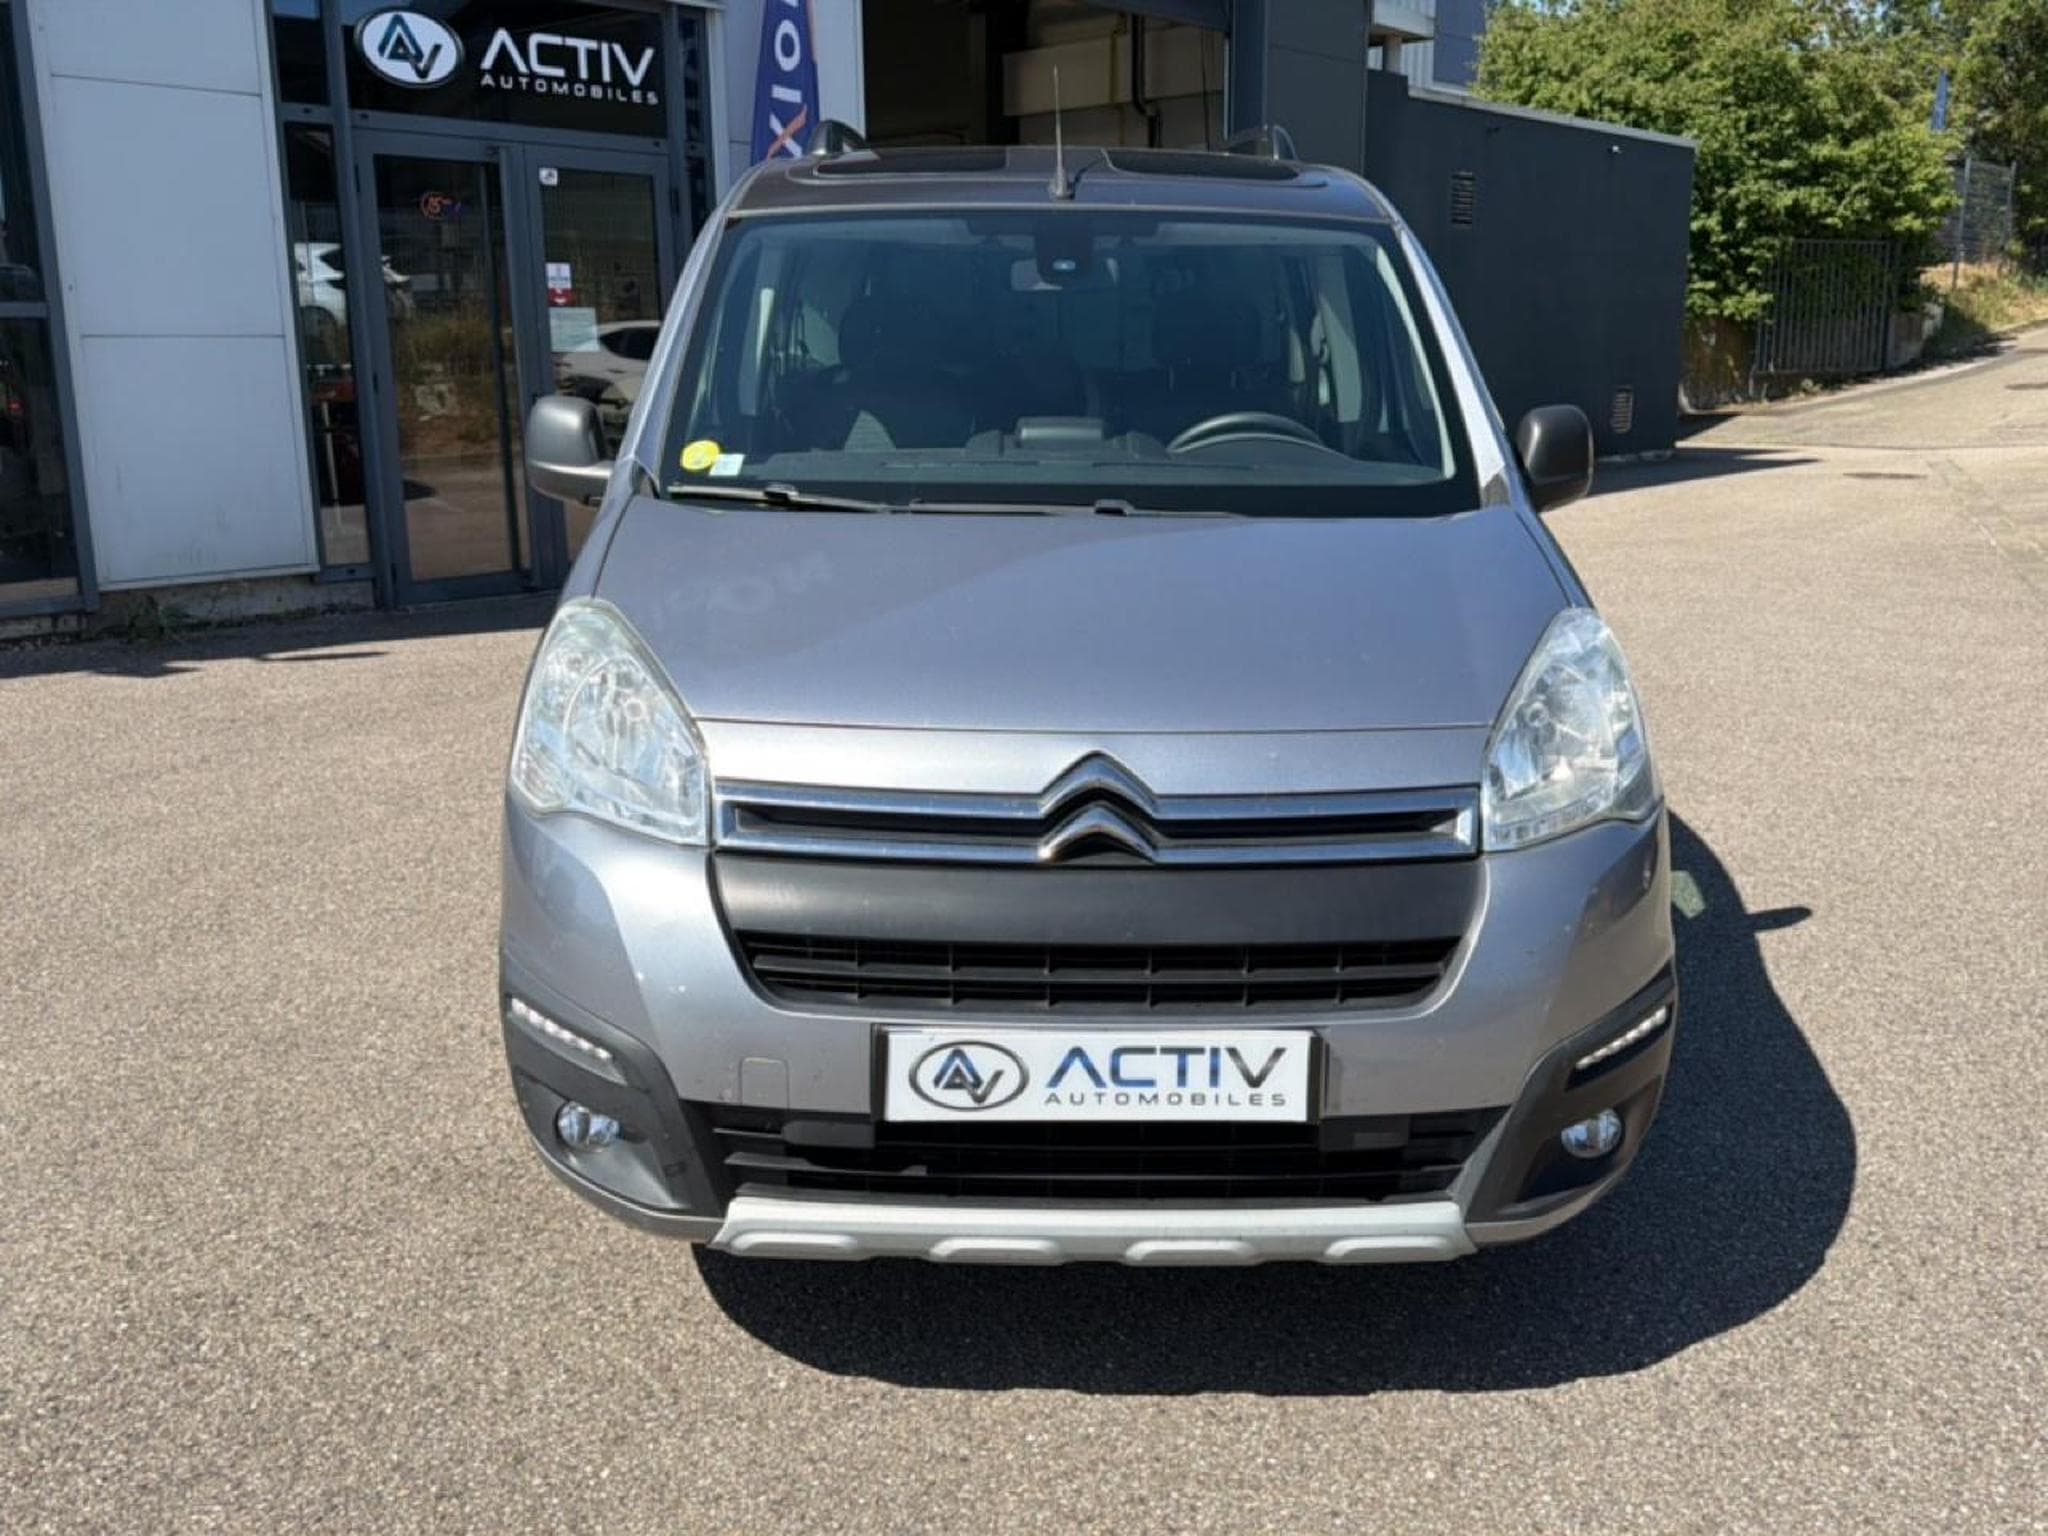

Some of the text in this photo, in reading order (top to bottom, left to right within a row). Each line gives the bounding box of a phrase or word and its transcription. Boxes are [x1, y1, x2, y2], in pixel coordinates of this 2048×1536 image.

[480, 27, 655, 87] ACTIV
[480, 74, 659, 106] AUTOMOBILES
[1045, 1046, 1287, 1089] ACTIV
[1044, 1092, 1287, 1107] AUTOMOBILES
